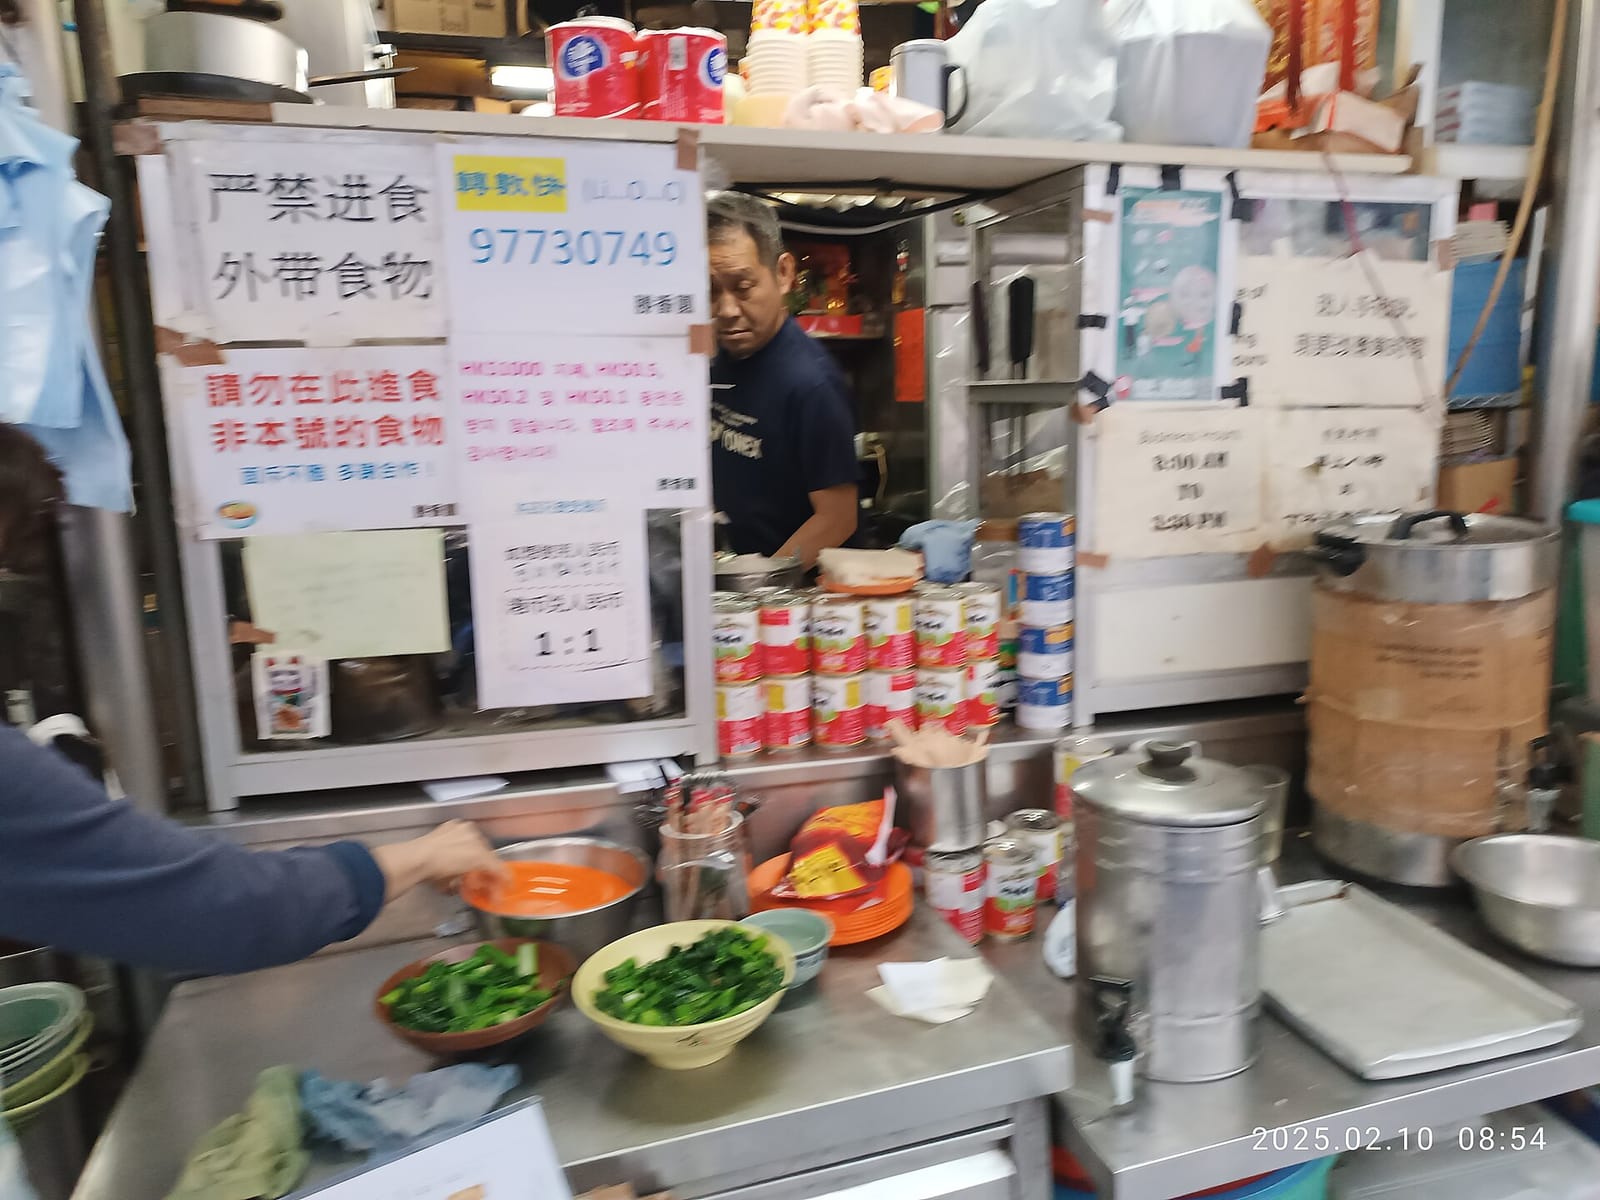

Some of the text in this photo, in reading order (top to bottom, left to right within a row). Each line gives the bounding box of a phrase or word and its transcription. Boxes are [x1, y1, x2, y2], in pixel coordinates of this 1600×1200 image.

[208, 173, 430, 223] 严禁进食
[456, 171, 567, 197] 轉數快
[469, 227, 678, 266] 97730749
[213, 252, 433, 301] 外带食物
[206, 369, 440, 407] 請勿在此進食
[211, 415, 445, 451] 非本號的食物
